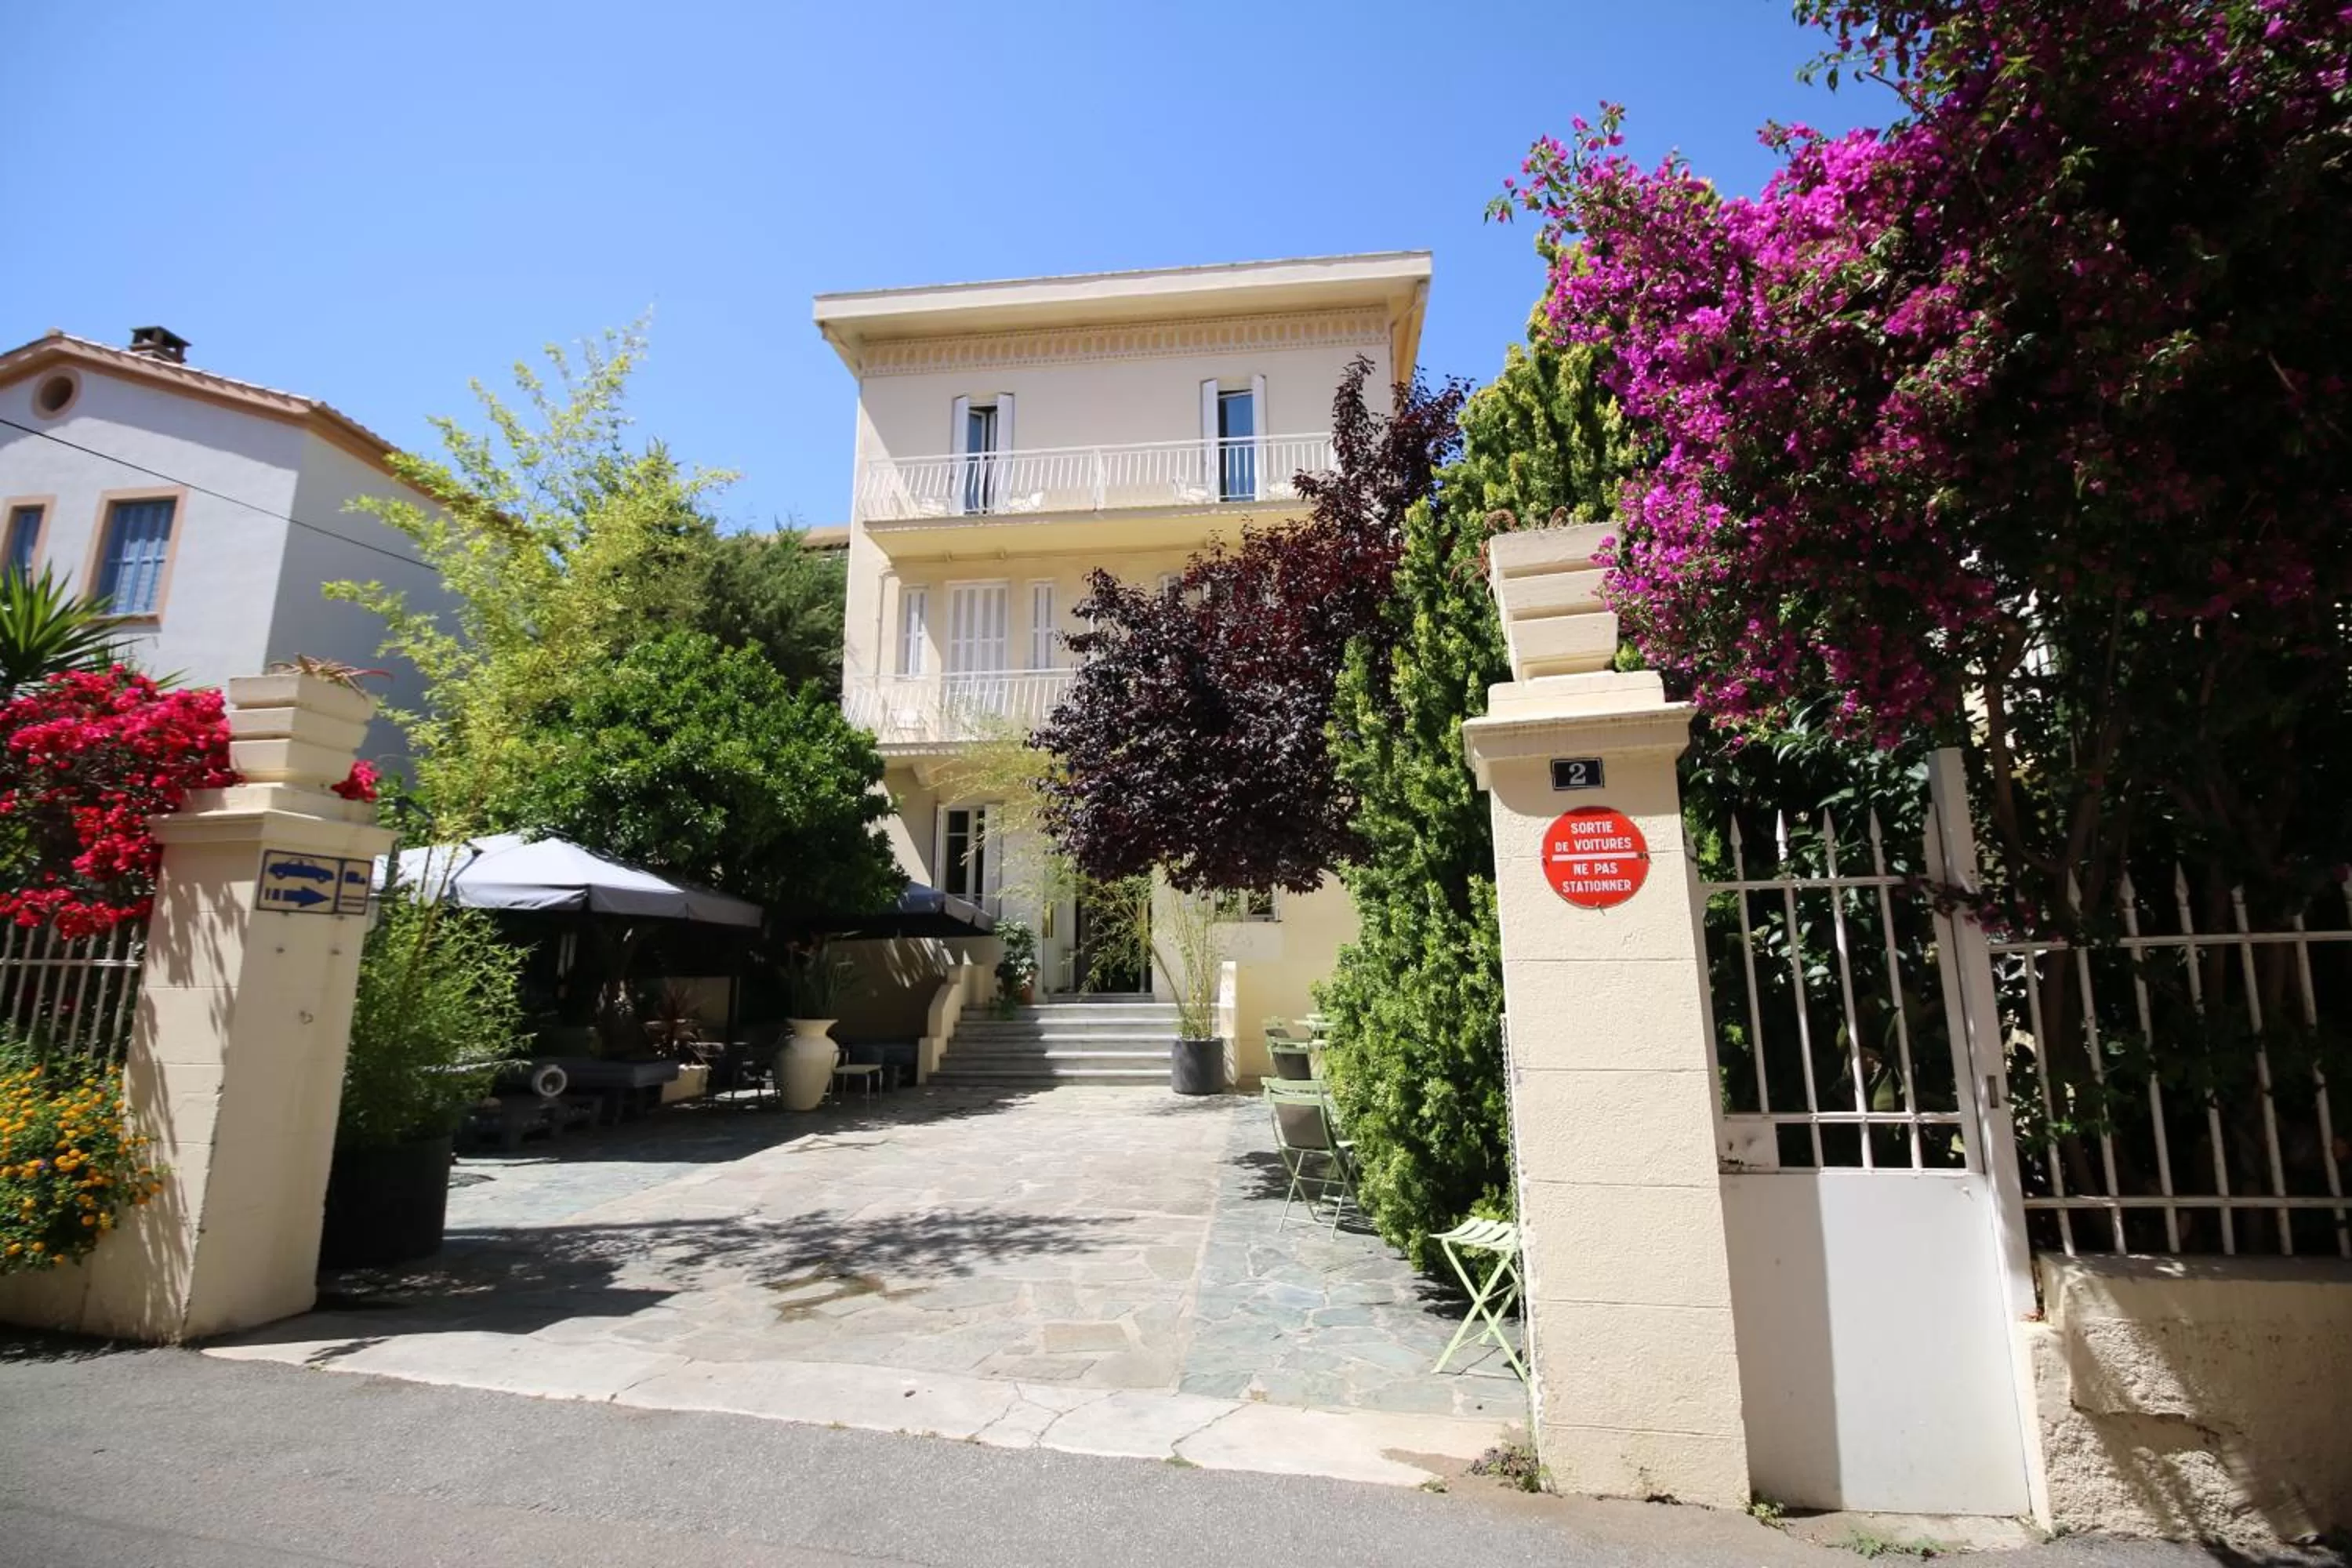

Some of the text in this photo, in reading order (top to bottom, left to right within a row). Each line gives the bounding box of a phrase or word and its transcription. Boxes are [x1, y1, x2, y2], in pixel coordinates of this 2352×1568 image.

[1569, 763, 1586, 785] 2
[1570, 821, 1613, 835] SORTIE
[1555, 837, 1632, 852] DE VOITURES
[1573, 862, 1618, 875] NE PAS
[1563, 879, 1632, 893] STATIONNER
